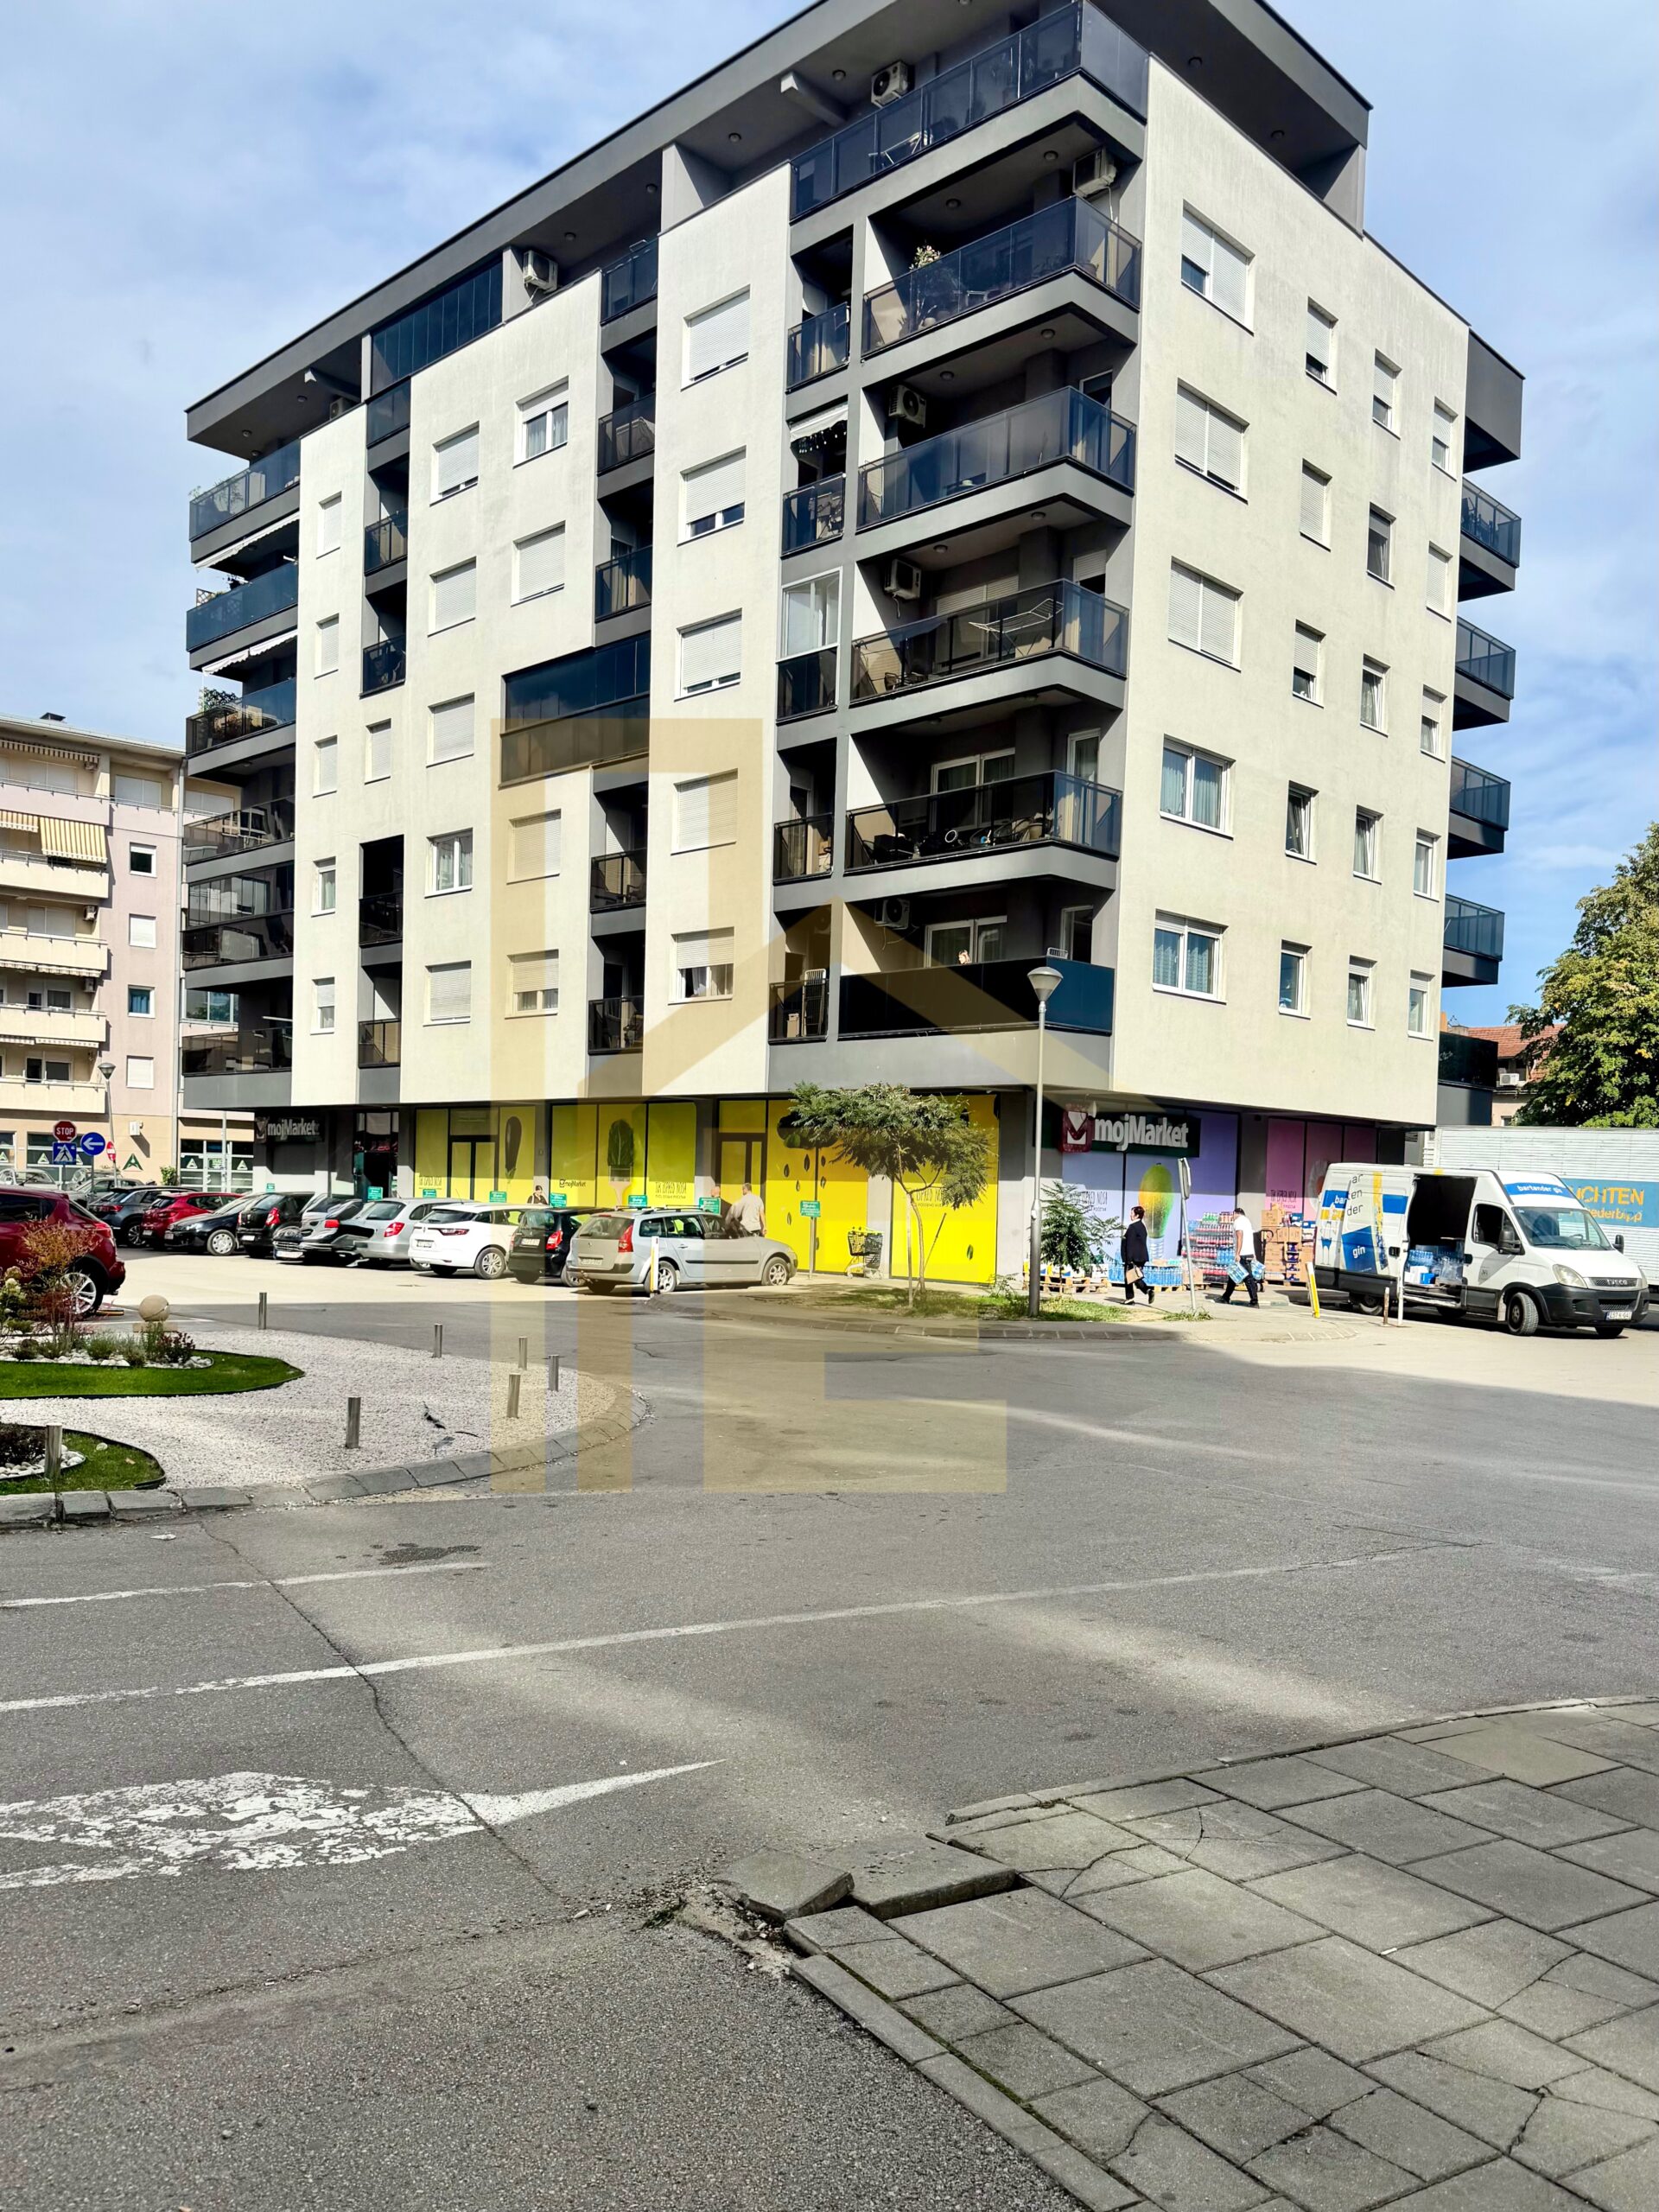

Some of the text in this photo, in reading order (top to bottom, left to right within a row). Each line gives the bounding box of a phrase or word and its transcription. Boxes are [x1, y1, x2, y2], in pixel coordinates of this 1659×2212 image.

[56, 1127, 74, 1135] STOP
[267, 1118, 316, 1141] mojMarket
[1094, 1113, 1189, 1152] mojMarket
[1346, 1205, 1363, 1217] der
[1352, 1245, 1365, 1259] gin
